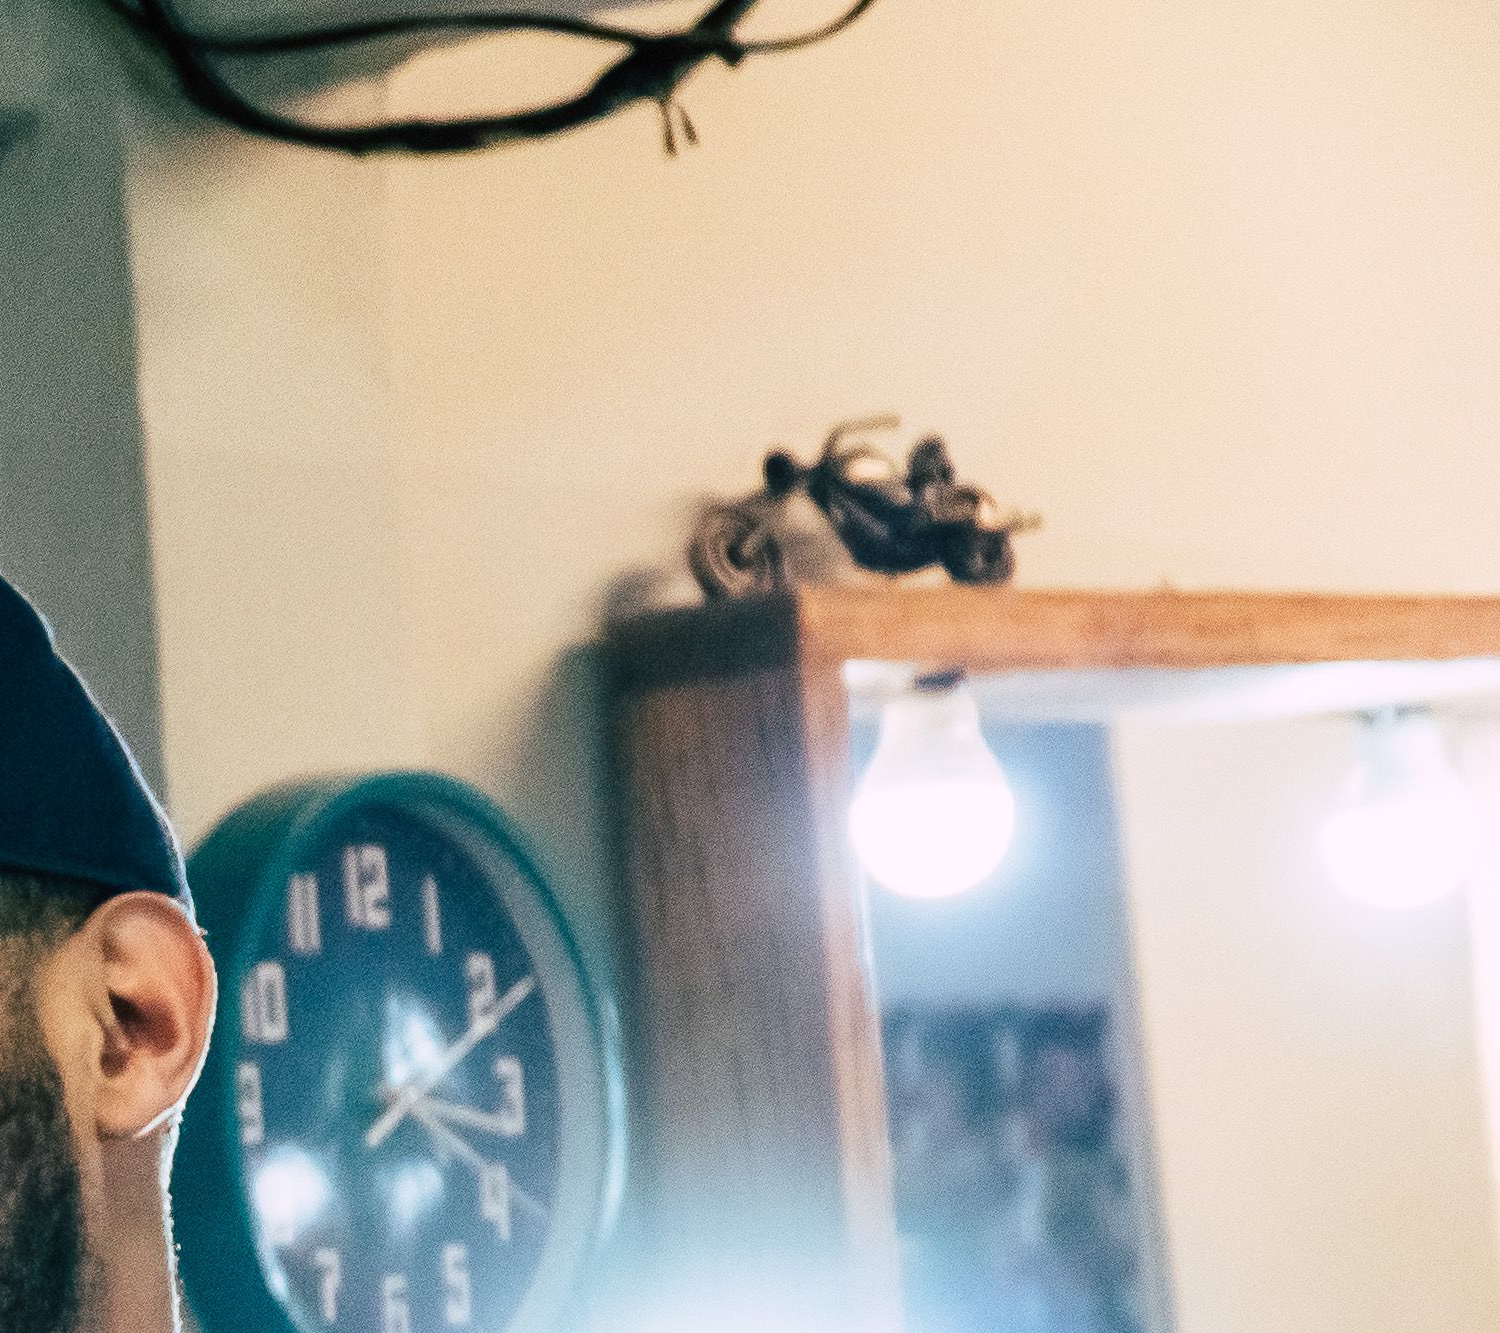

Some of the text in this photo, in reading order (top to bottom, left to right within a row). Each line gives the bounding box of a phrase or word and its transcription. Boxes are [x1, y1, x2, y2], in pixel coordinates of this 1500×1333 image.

[288, 874, 321, 954] 11
[344, 845, 391, 929] 12
[423, 875, 442, 955] 1
[241, 962, 288, 1044] 10
